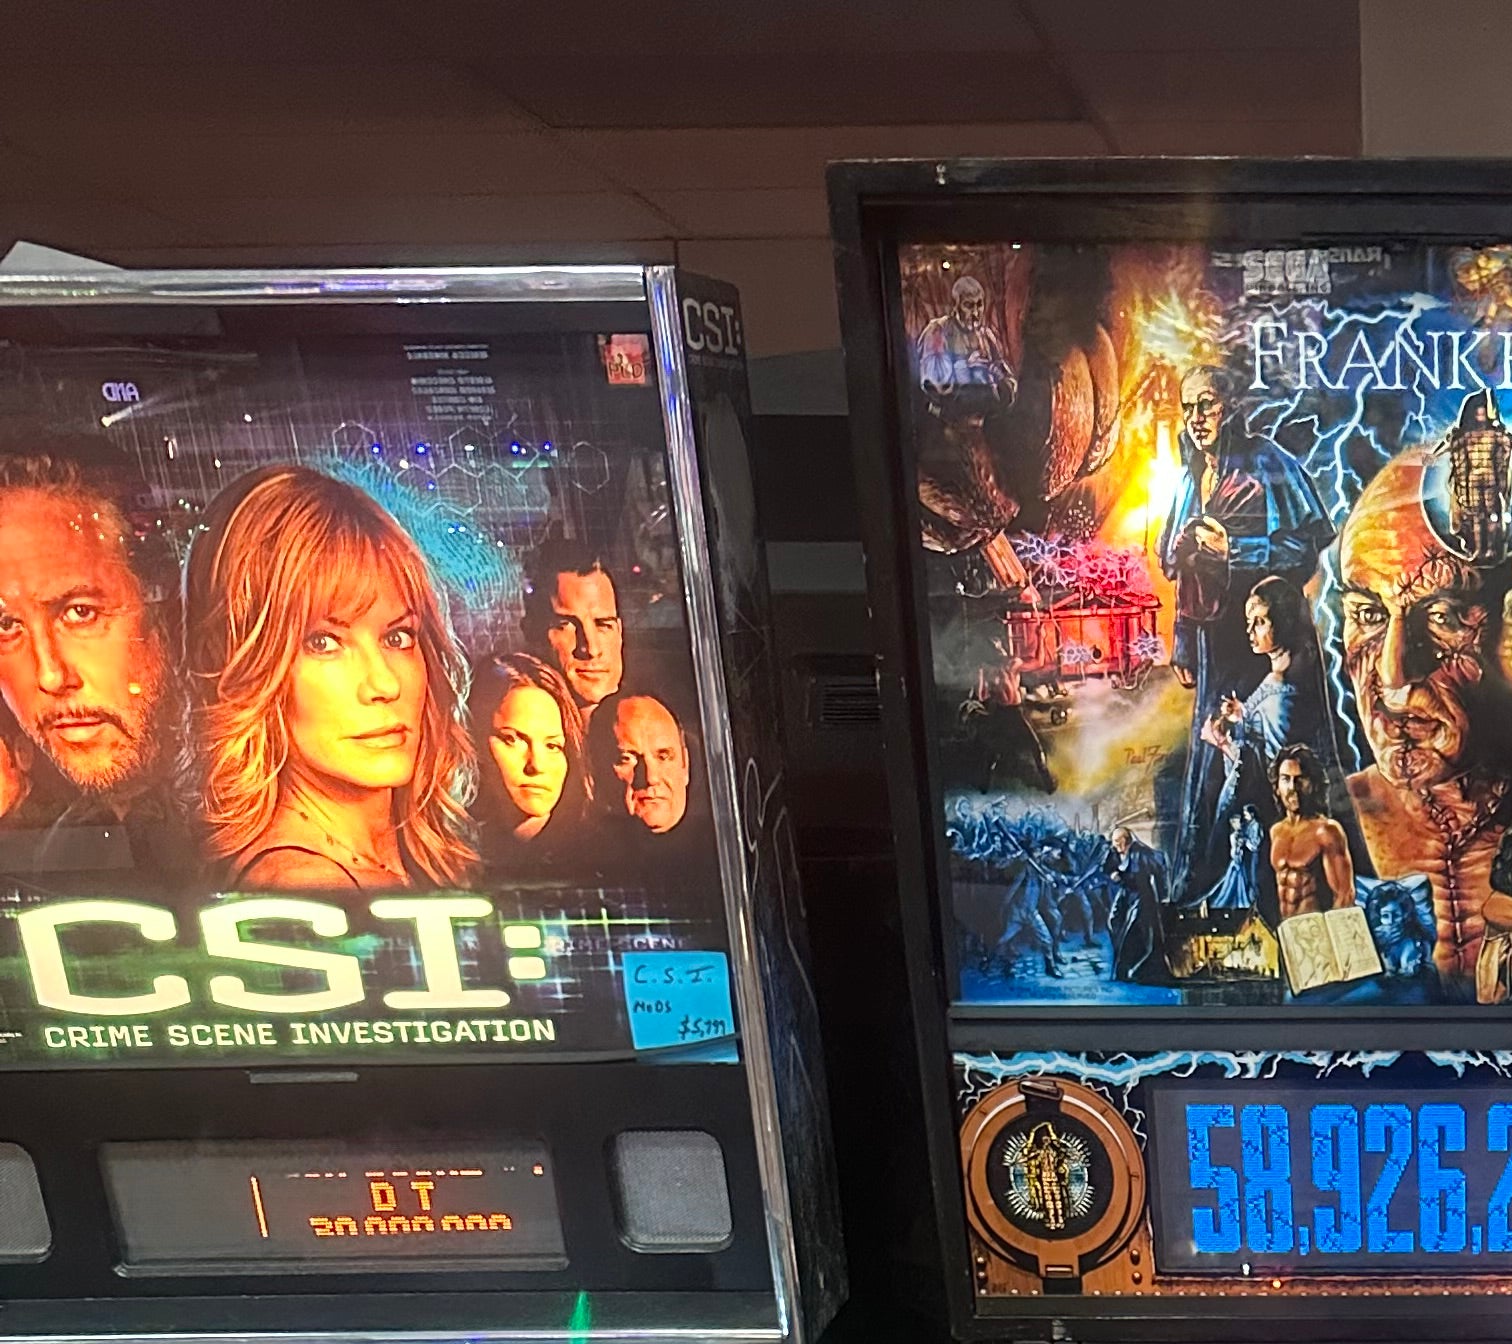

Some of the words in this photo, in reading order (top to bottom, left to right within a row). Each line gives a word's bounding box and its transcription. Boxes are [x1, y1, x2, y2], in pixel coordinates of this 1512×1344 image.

[18, 899, 547, 1016] CSI:
[44, 1026, 154, 1049] CRIME
[168, 1023, 277, 1047] SCENE
[290, 1018, 557, 1046] INVESTIGATION
